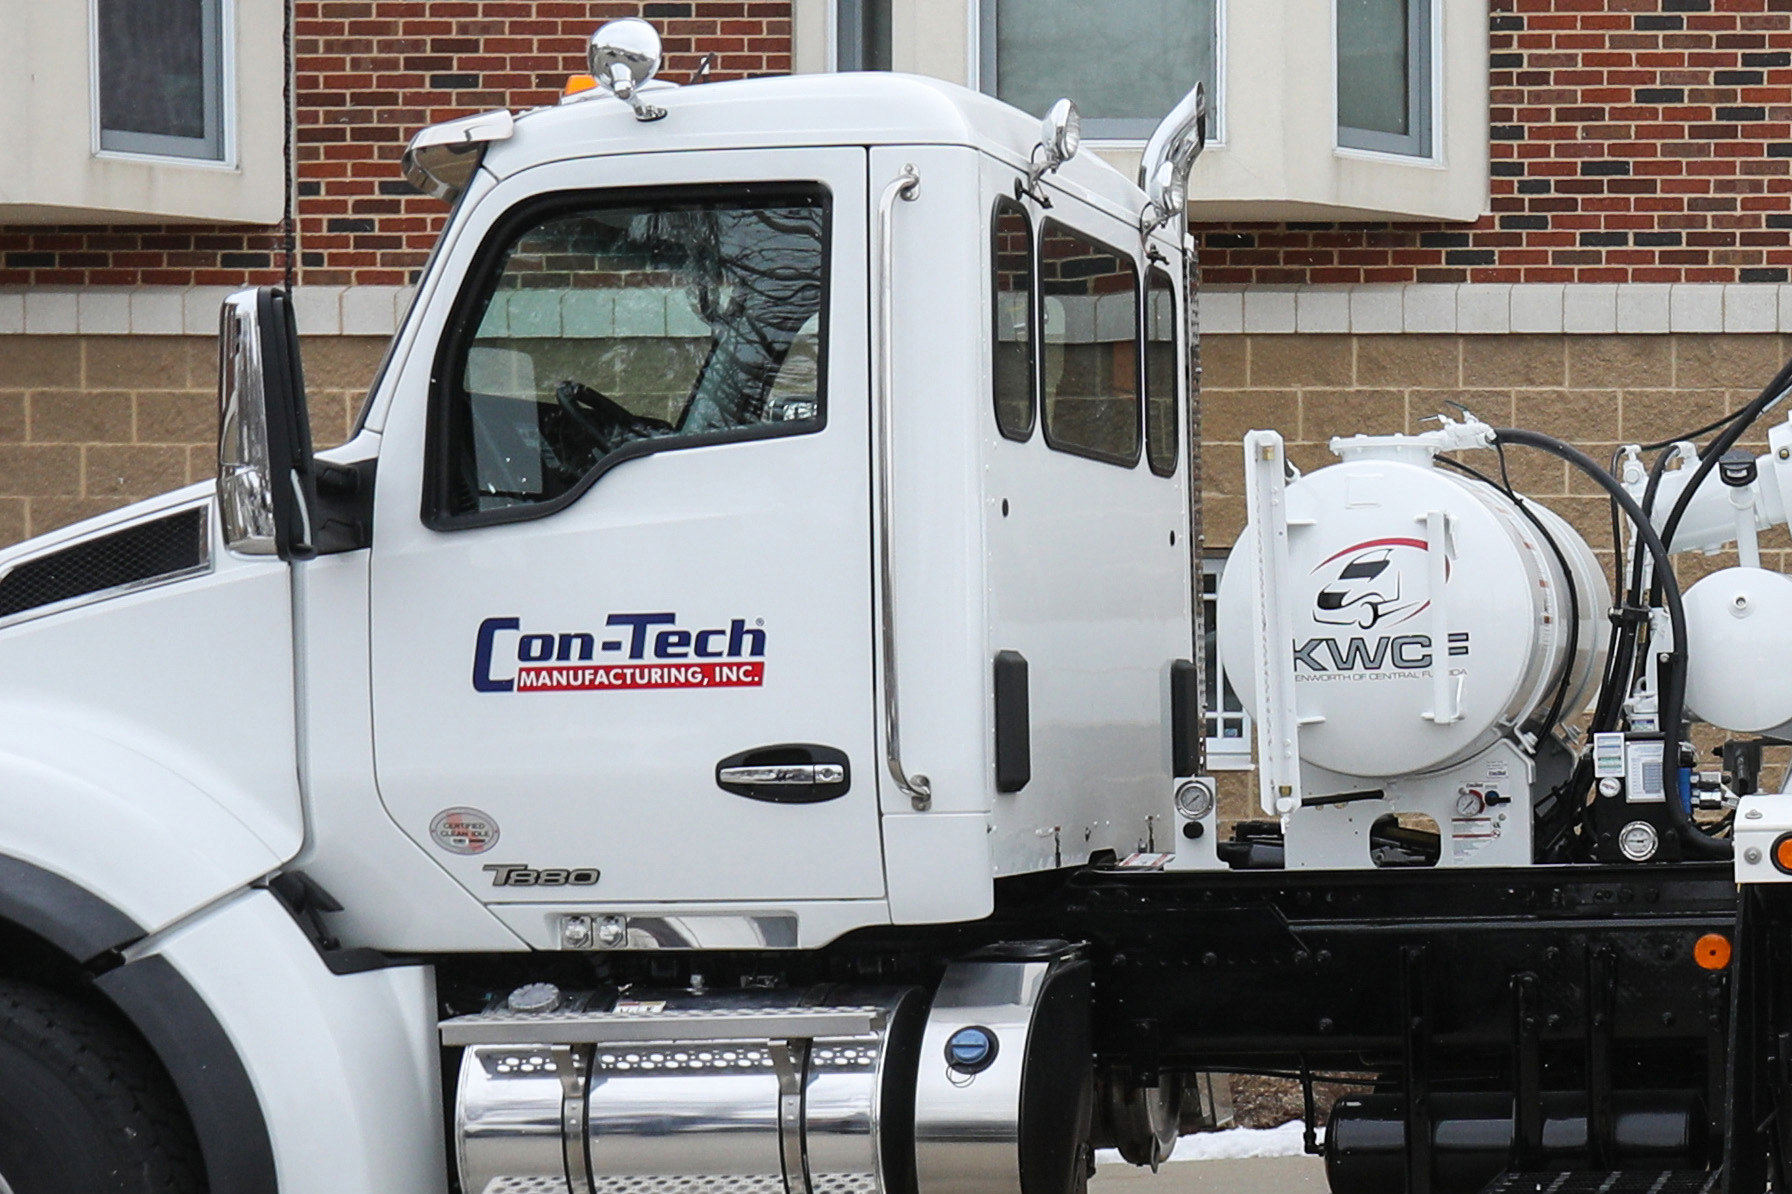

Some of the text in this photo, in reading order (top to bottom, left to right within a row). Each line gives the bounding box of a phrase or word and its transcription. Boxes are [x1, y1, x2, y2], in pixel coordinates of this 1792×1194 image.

[519, 665, 759, 687] MANUFACTURING, INC.
[1294, 673, 1351, 682] ENWORTH
[1353, 673, 1366, 681] OF
[1368, 671, 1419, 680] CENTRAL
[482, 864, 601, 887] T880
